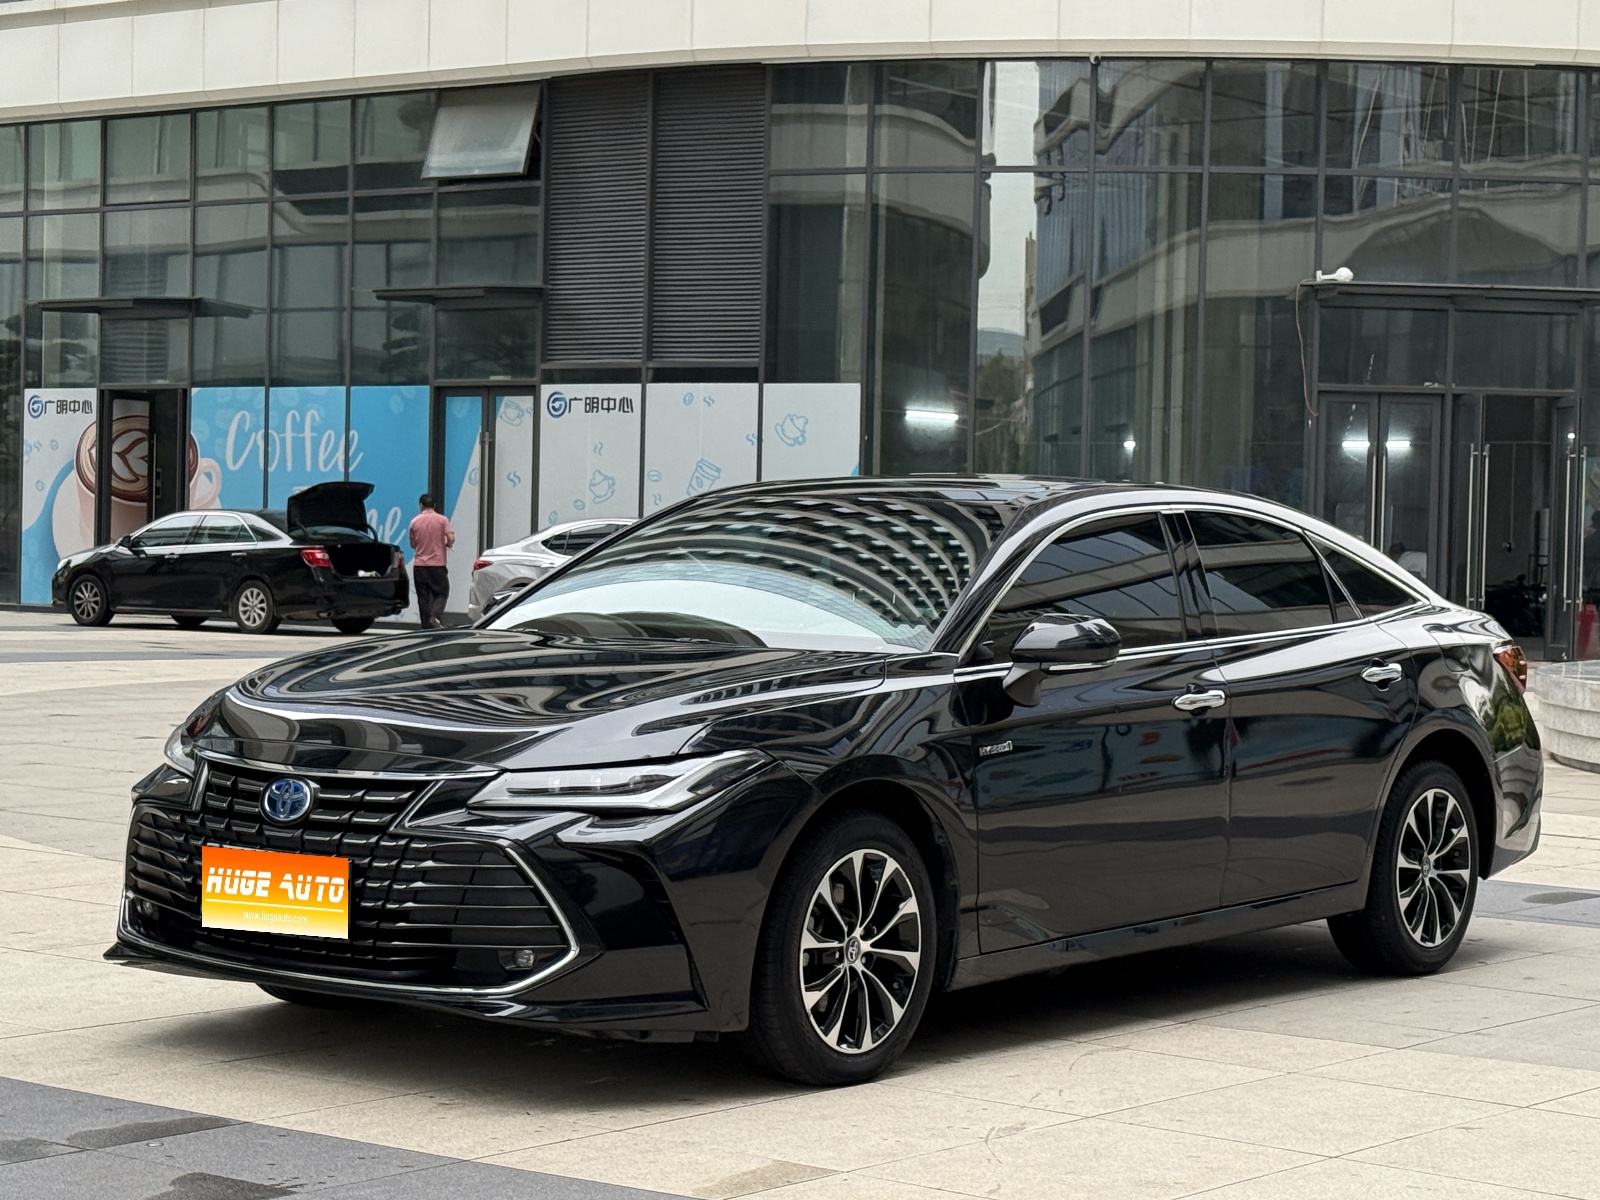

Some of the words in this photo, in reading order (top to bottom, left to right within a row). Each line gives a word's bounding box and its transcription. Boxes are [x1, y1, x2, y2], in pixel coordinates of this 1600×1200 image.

[44, 399, 93, 415] 广明中心
[568, 396, 634, 413] 广明中心
[225, 409, 364, 473] Coffee
